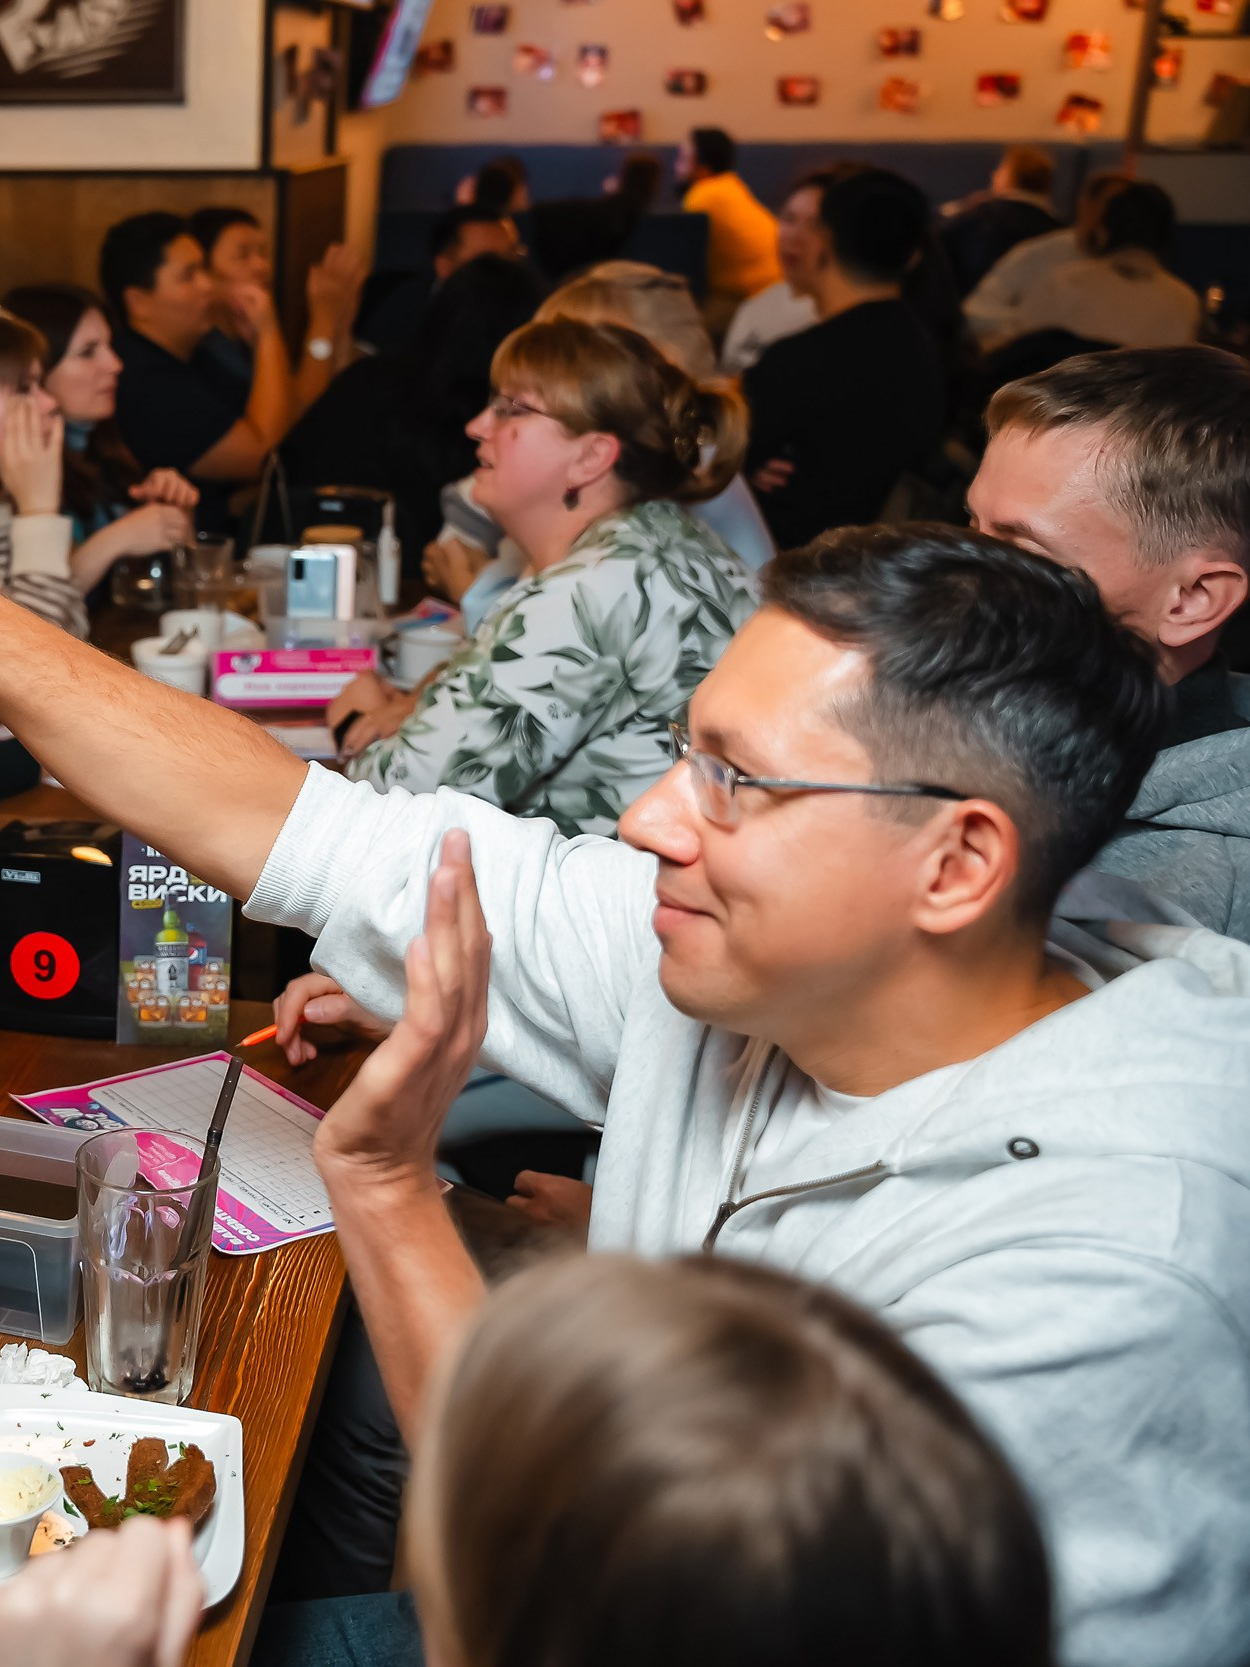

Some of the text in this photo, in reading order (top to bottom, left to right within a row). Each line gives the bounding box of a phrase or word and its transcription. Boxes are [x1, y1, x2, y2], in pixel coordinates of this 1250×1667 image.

[128, 865, 189, 885] ЯРД
[128, 883, 228, 903] ВИСКИ
[34, 949, 57, 983] 9
